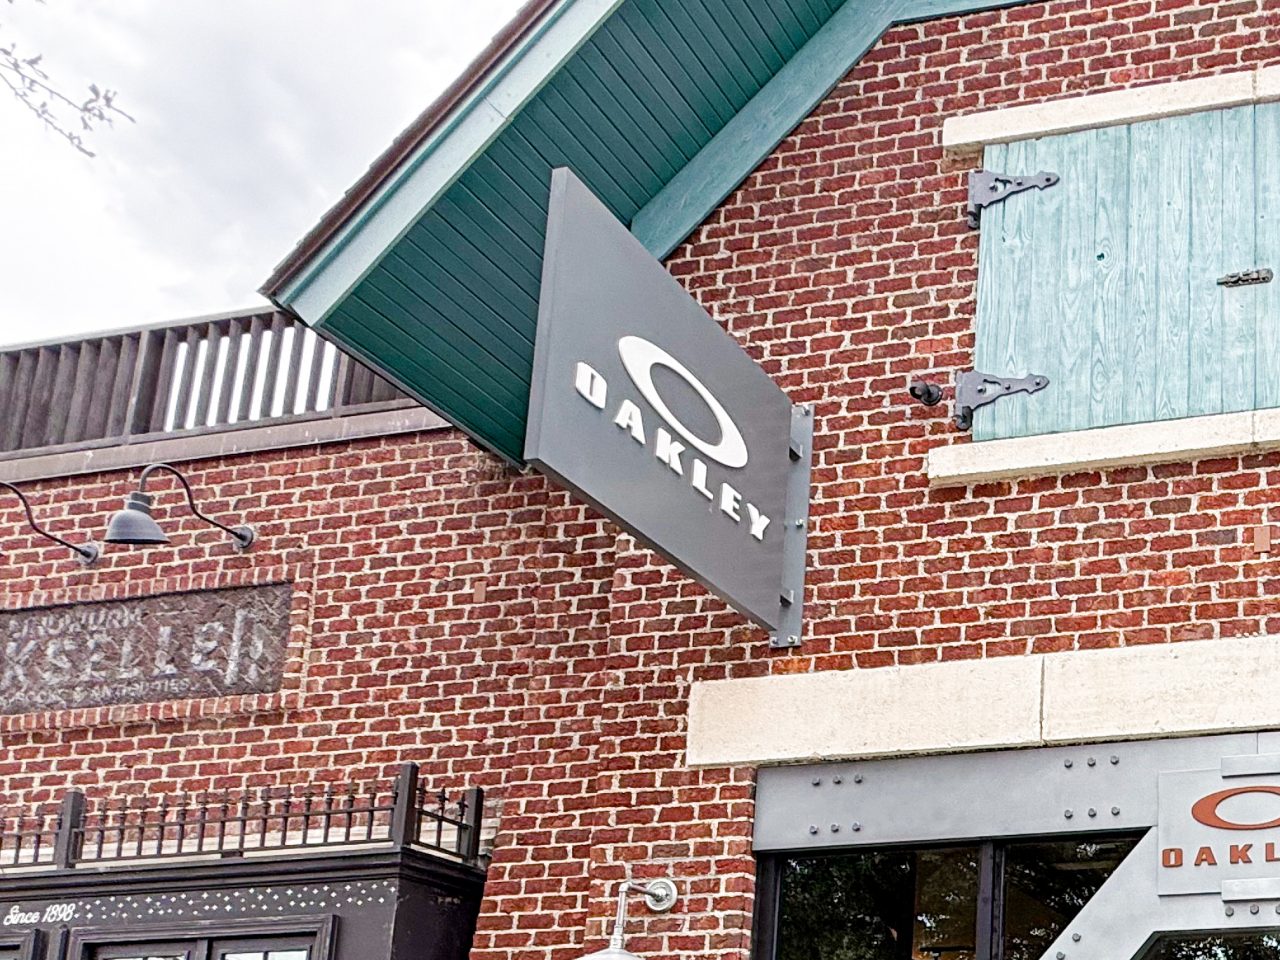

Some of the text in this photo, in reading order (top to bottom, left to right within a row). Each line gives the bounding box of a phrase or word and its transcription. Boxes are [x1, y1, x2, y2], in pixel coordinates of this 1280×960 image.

[575, 361, 771, 541] OAKLEY
[3, 902, 77, 926] Since 1898
